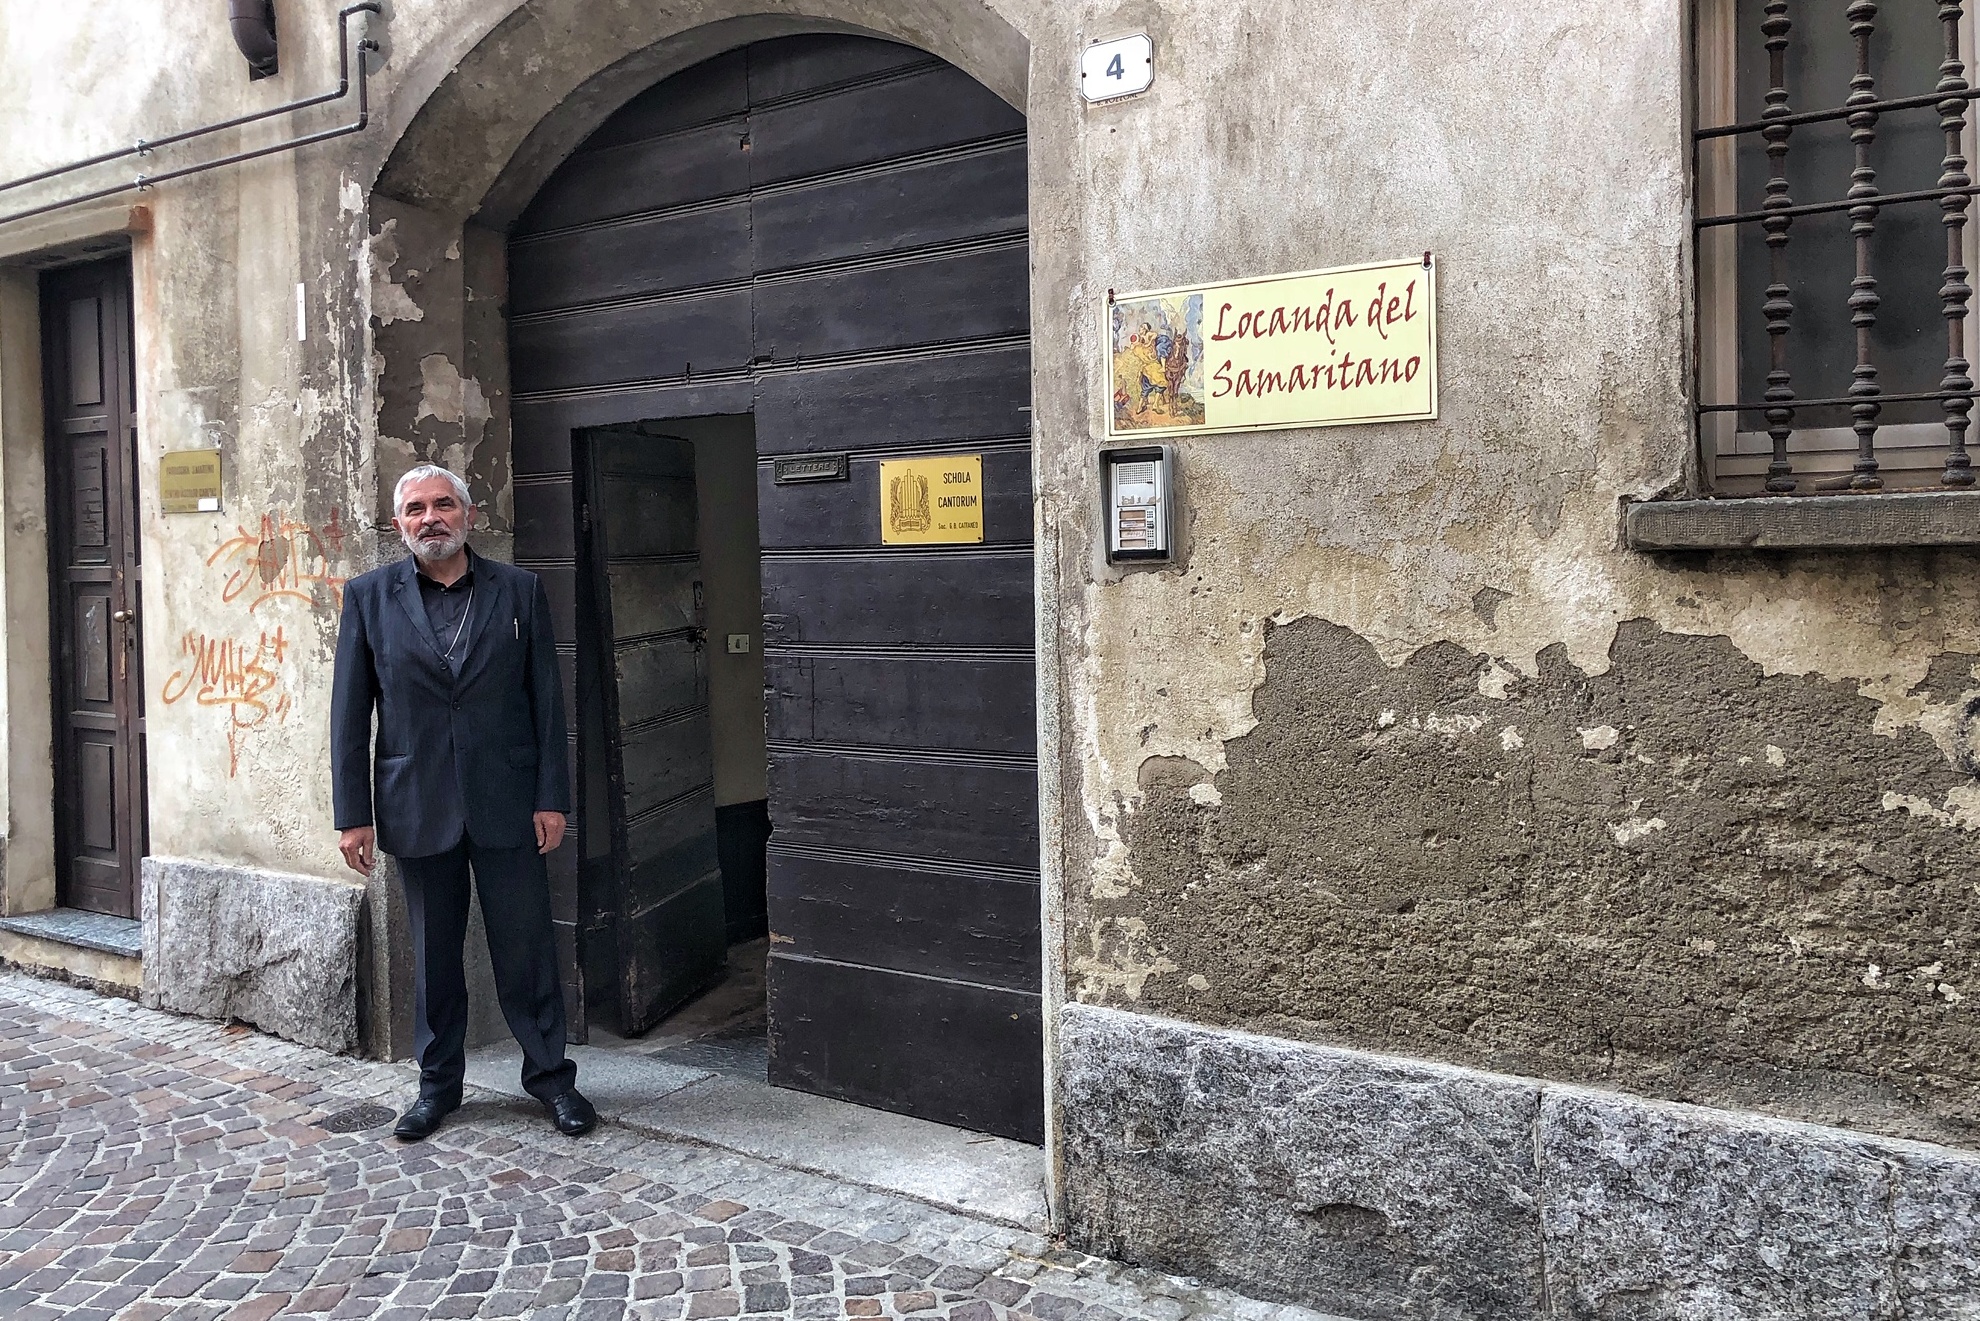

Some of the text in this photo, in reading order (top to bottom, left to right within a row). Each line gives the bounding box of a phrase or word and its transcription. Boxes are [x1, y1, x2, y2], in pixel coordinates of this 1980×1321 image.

[1106, 53, 1125, 80] 4
[1211, 279, 1417, 345] Locanda del
[1212, 349, 1421, 398] Samaritano
[790, 462, 830, 473] LETTERE
[943, 471, 971, 484] SCHOLA
[938, 495, 977, 508] CANTORUM
